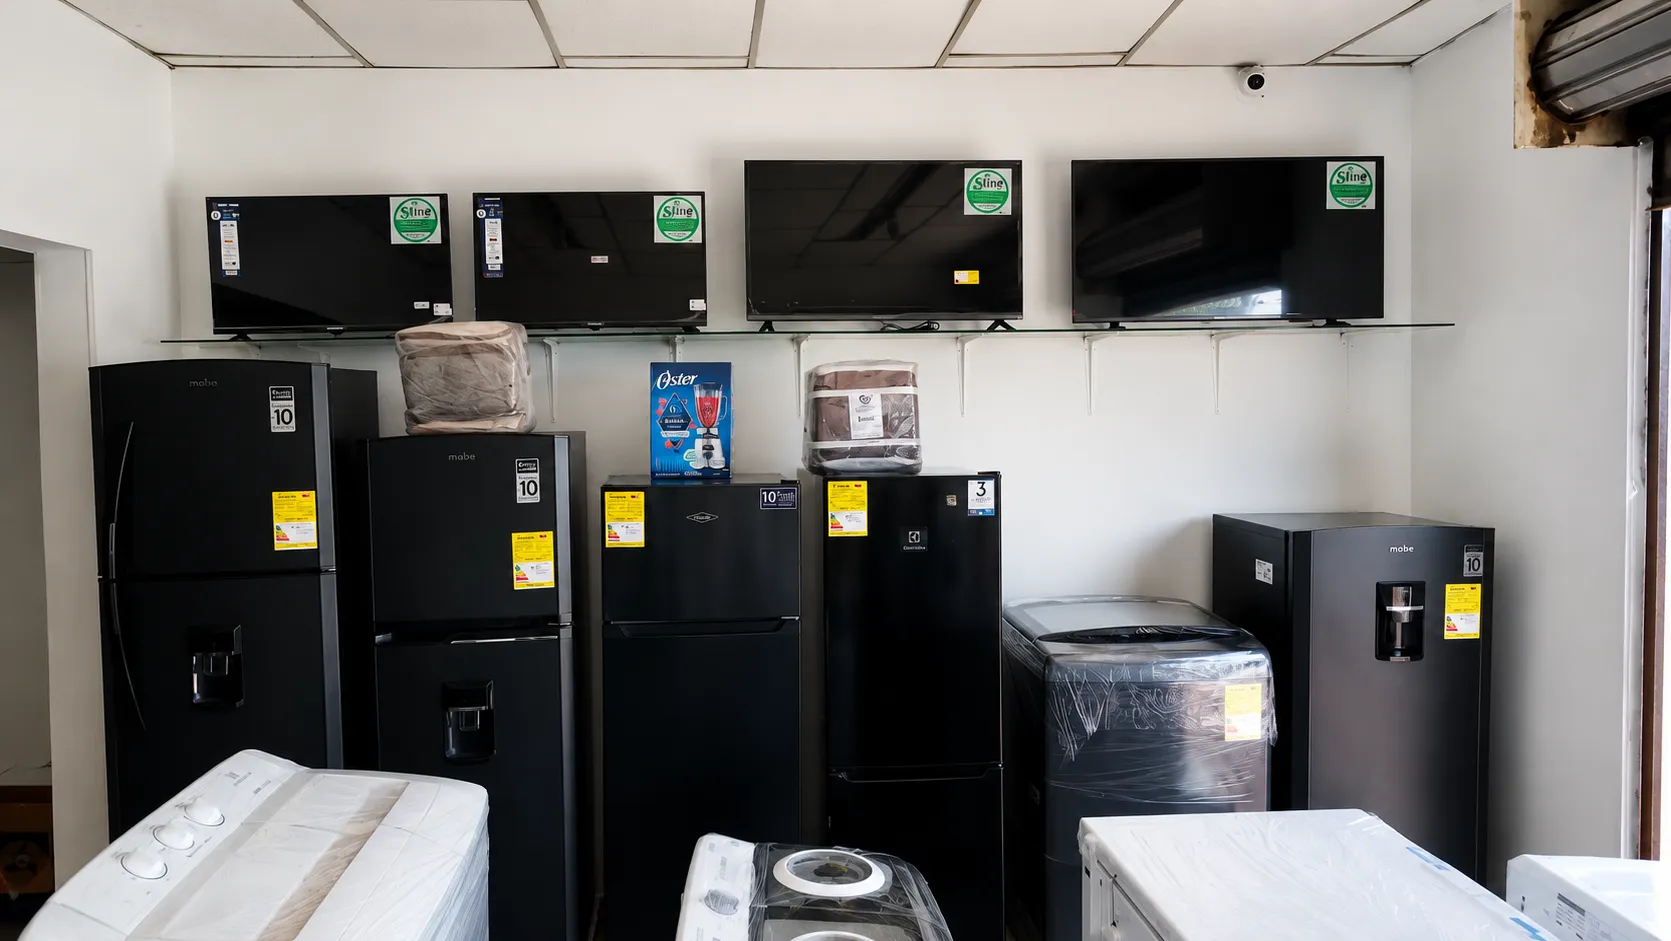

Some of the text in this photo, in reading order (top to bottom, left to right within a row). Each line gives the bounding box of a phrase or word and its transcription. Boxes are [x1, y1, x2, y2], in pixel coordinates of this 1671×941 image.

[656, 370, 698, 390] Oster
[273, 409, 293, 425] 10
[519, 479, 538, 496] 10
[976, 481, 986, 497] 3
[762, 491, 777, 503] 10
[1466, 557, 1481, 572] 10
